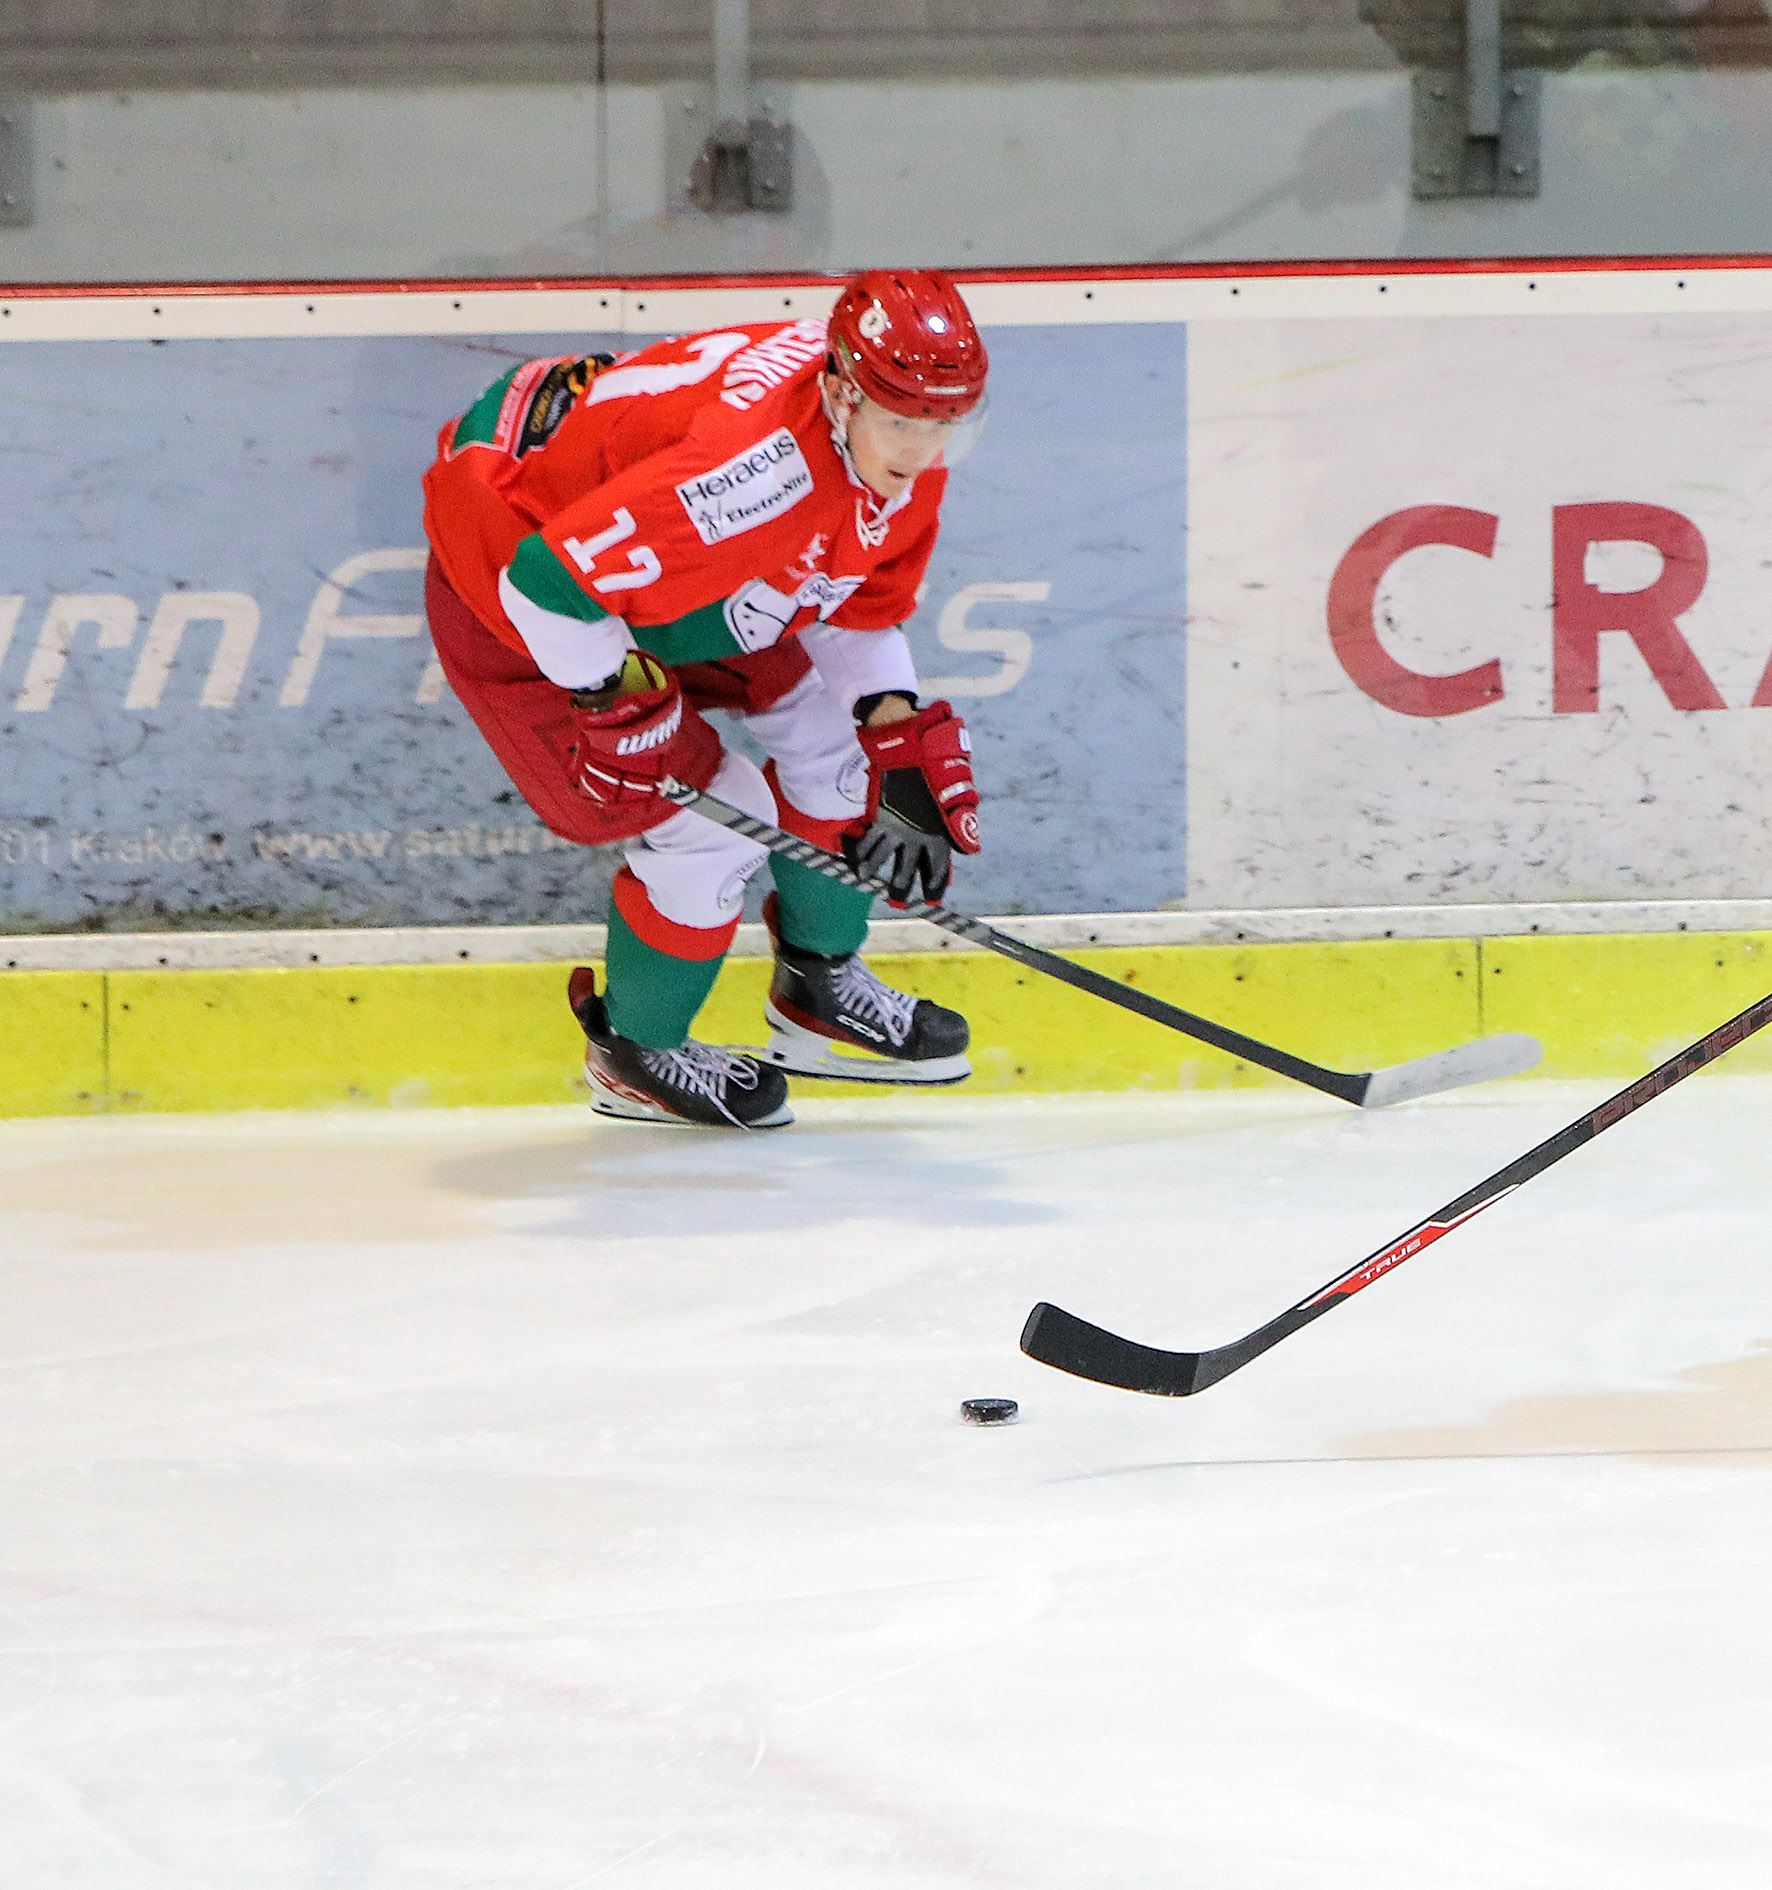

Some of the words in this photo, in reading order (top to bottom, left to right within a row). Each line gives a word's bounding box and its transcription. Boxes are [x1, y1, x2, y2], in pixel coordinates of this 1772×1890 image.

[680, 434, 797, 507] Heraeus
[562, 506, 663, 594] 17
[1359, 1237, 1423, 1281] TRUE
